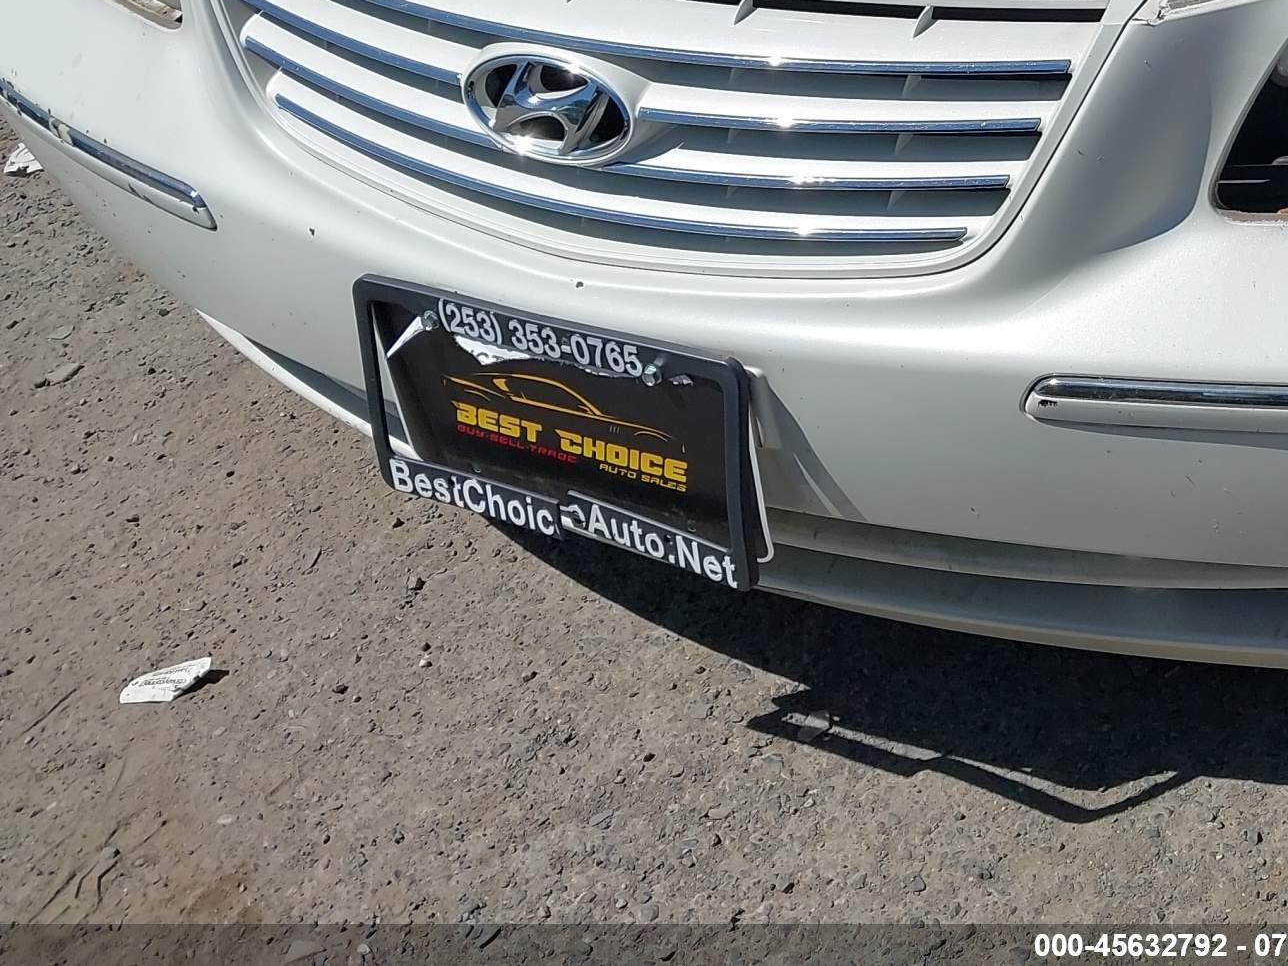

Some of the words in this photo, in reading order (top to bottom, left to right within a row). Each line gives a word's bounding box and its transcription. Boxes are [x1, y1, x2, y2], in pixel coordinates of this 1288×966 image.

[438, 298, 503, 345] (253)
[508, 319, 643, 377] 353-0765
[451, 400, 542, 442] BEST
[555, 429, 688, 483] CHOICE
[599, 463, 637, 479] AUTO
[640, 474, 688, 493] SALES
